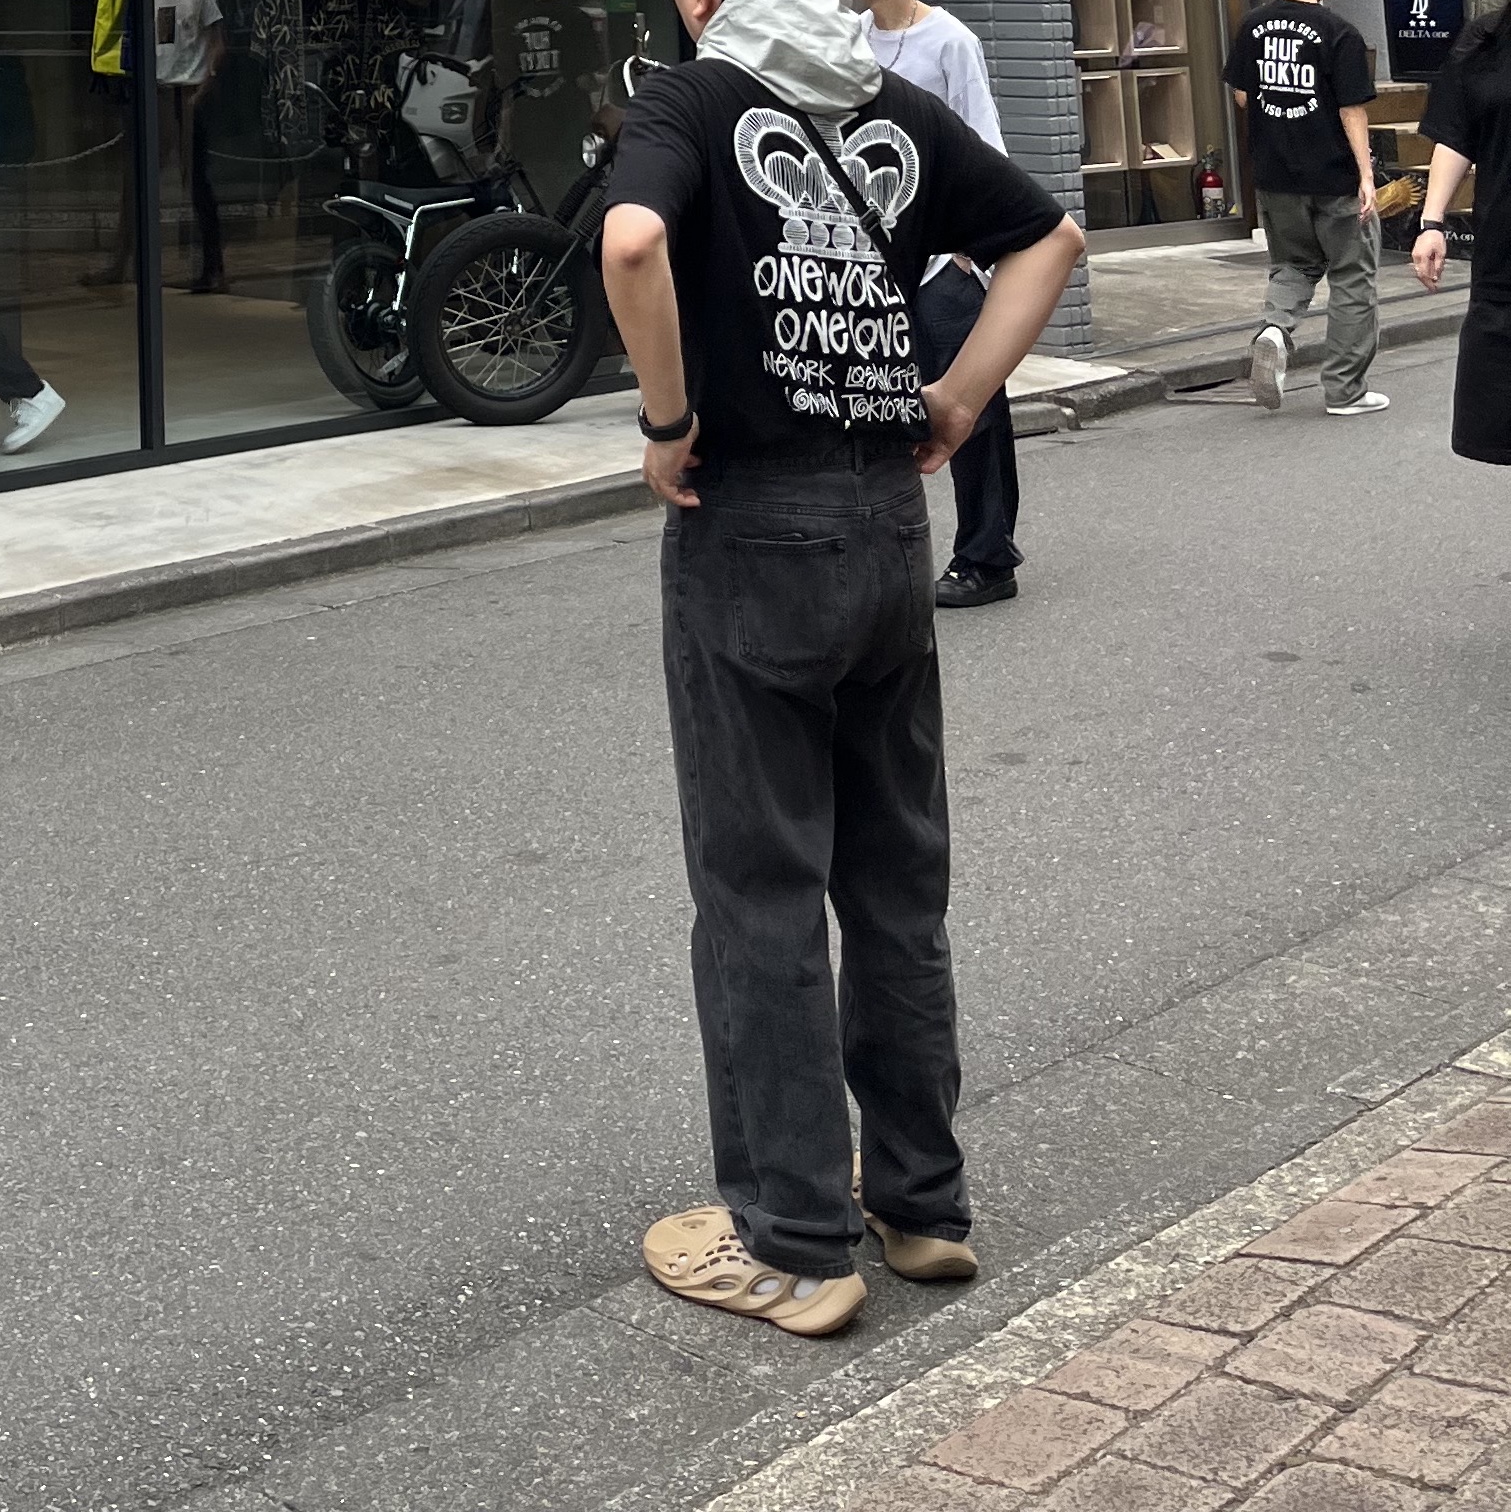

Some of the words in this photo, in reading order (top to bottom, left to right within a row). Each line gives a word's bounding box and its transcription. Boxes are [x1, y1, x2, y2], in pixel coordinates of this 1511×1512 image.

[1398, 29, 1431, 38] DELTA
[1433, 30, 1450, 38] one
[1264, 36, 1304, 62] HUF
[1256, 59, 1316, 88] TOKYO
